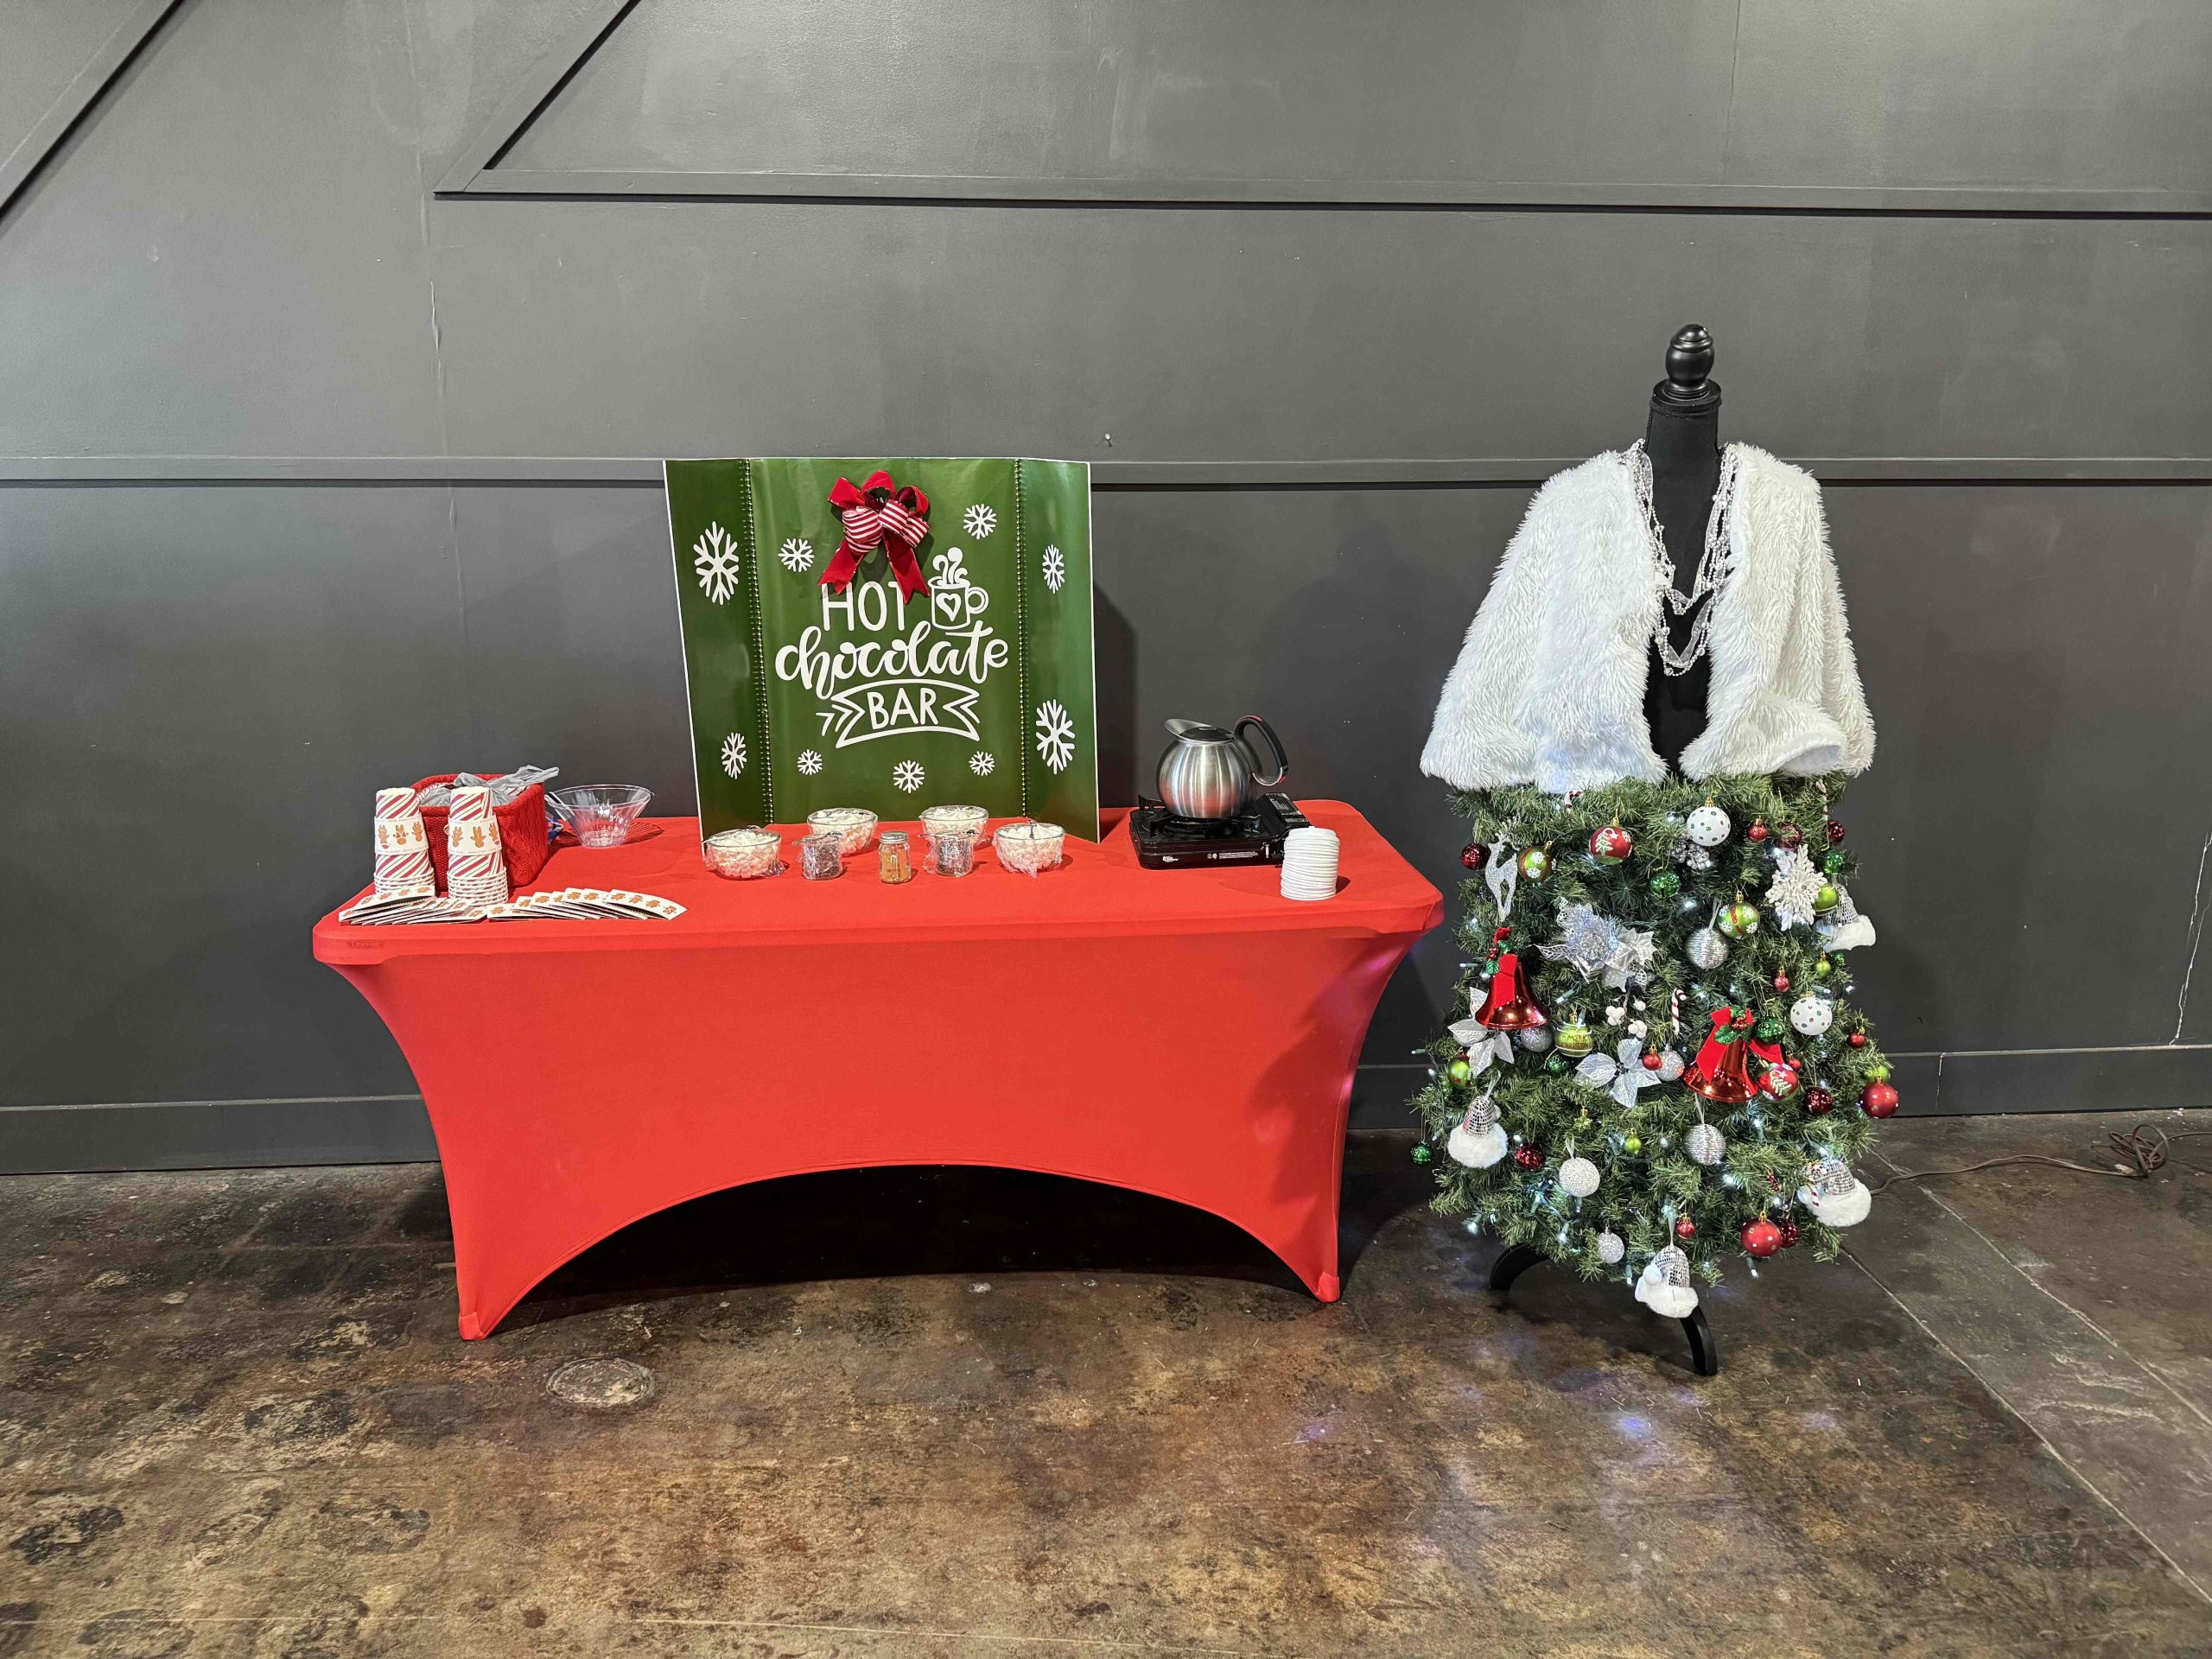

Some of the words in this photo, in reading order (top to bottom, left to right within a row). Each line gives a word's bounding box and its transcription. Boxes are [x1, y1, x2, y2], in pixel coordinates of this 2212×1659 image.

[822, 581, 905, 631] HOT
[775, 620, 1008, 700] chocolate
[867, 687, 938, 729] BAR
